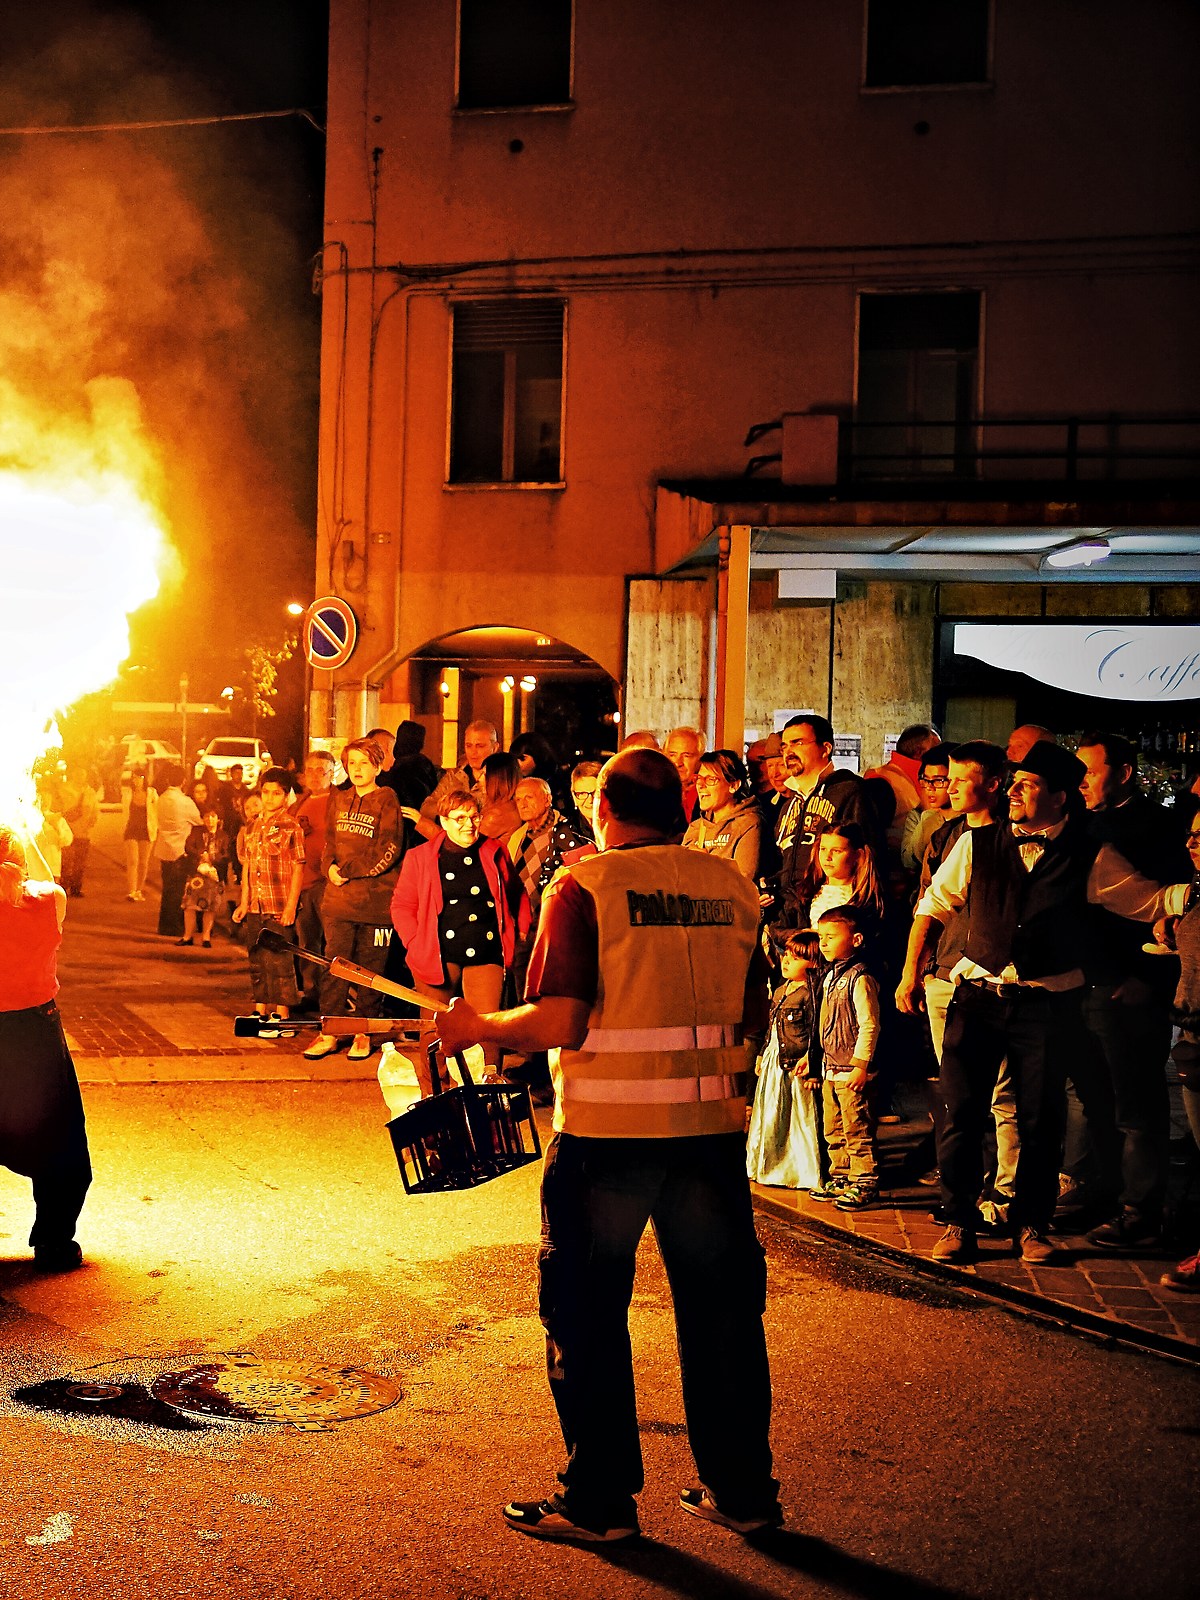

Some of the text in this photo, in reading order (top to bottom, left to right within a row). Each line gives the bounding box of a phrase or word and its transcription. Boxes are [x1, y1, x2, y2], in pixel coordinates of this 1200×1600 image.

[338, 811, 375, 824] HOLISTER
[336, 823, 374, 838] ALIFORNIA
[367, 842, 397, 877] HOLLIS
[374, 928, 393, 946] NY
